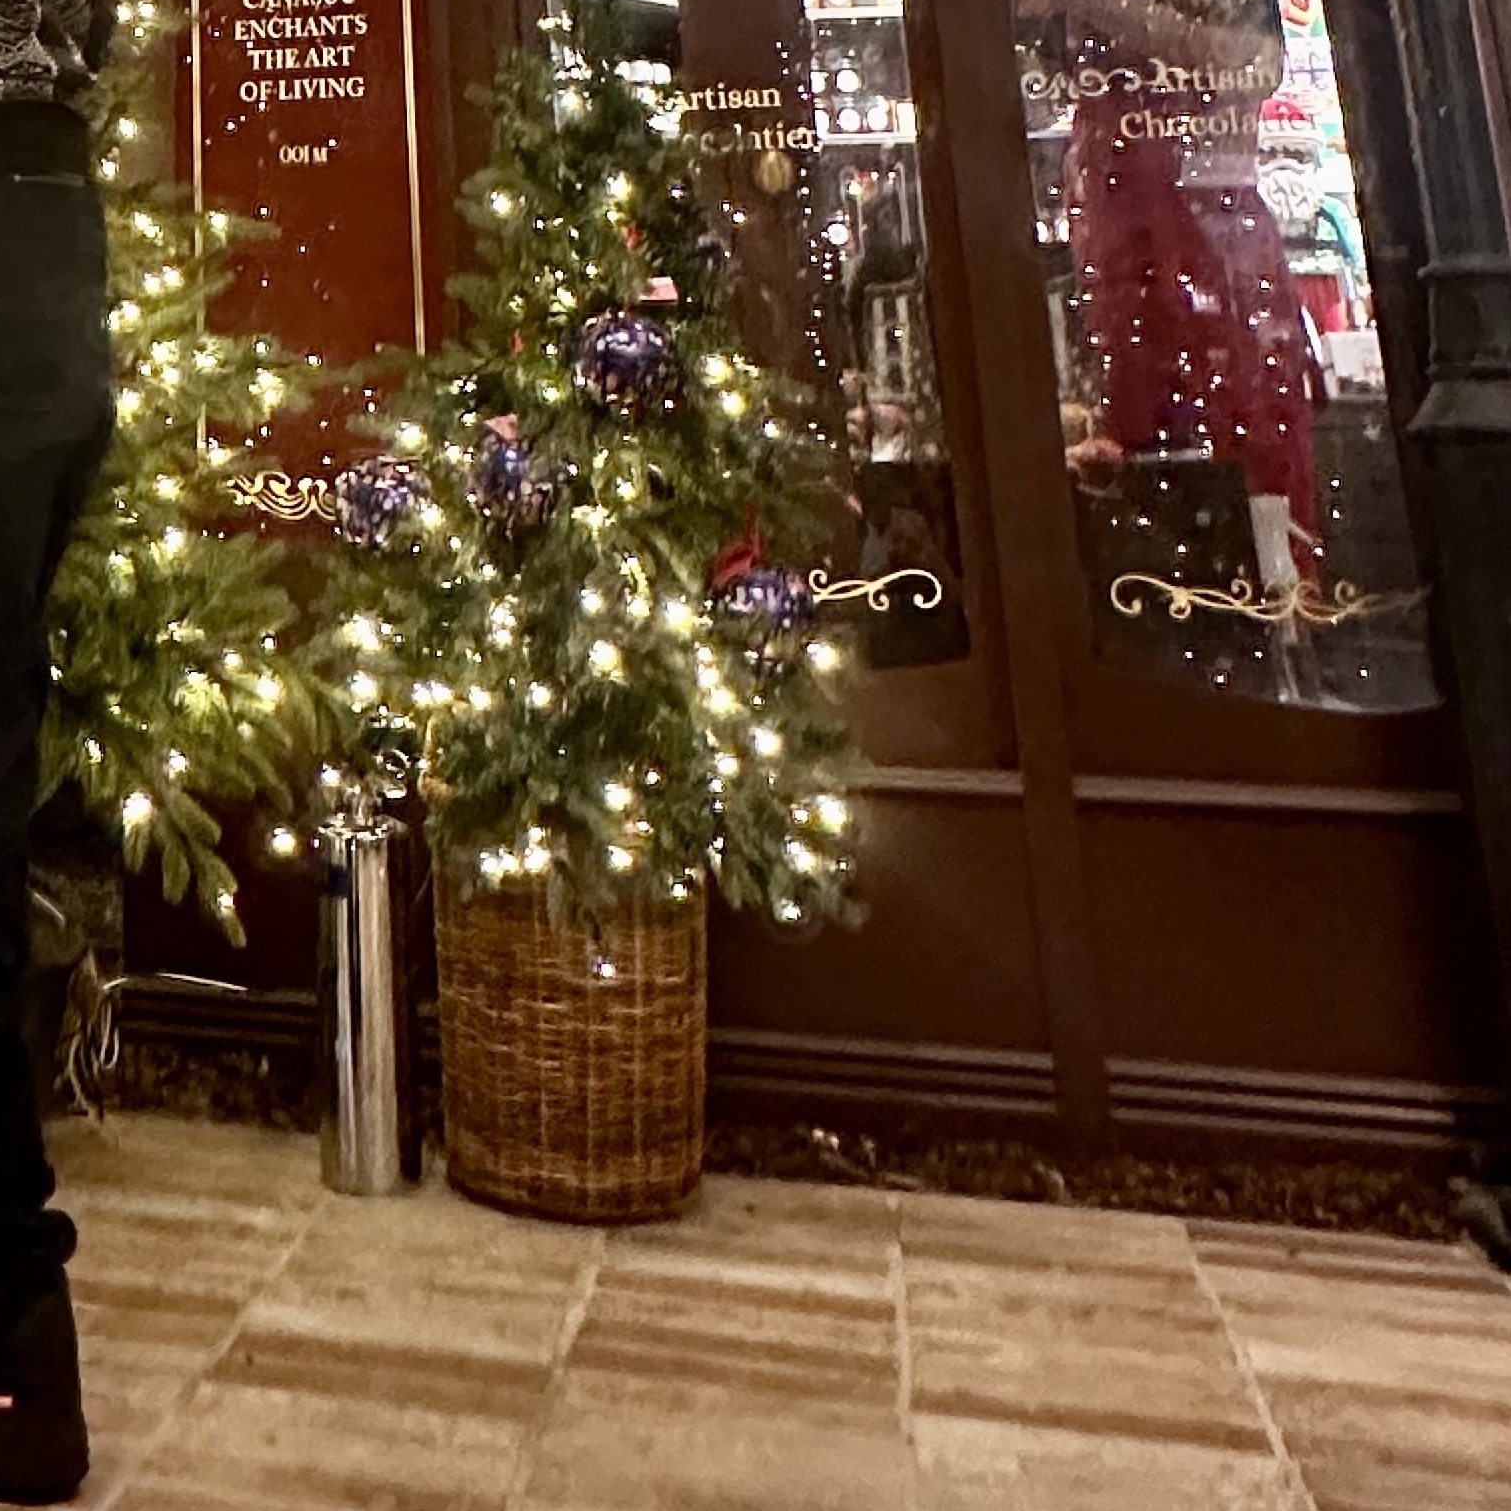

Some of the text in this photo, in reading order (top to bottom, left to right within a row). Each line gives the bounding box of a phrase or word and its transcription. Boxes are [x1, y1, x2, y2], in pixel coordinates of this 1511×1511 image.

[234, 13, 368, 40] ENCHANTS
[246, 45, 356, 70] THE ART
[240, 76, 366, 102] OF LIVING
